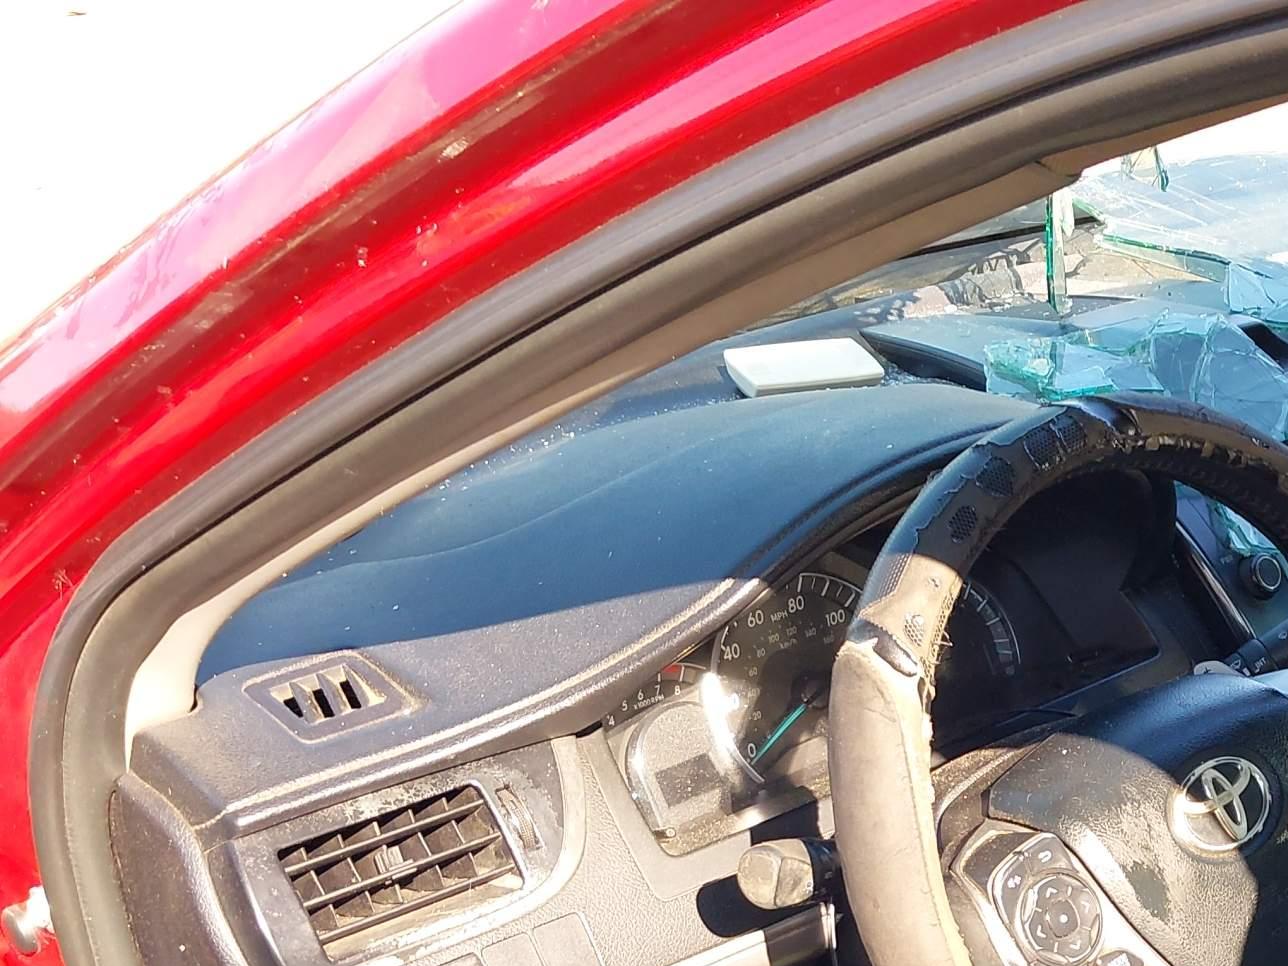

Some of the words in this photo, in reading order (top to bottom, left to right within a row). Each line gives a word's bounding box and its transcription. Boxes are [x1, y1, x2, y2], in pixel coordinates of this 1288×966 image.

[788, 596, 804, 613] 80
[747, 610, 764, 627] 60
[770, 611, 788, 623] MPH
[825, 609, 846, 626] 100
[768, 633, 780, 643] 100
[723, 643, 740, 661] 40
[637, 689, 644, 700] 6
[654, 685, 660, 696] 7
[674, 685, 681, 696] 8
[621, 700, 628, 711] 5
[608, 715, 615, 726] 4
[747, 743, 757, 758] 0
